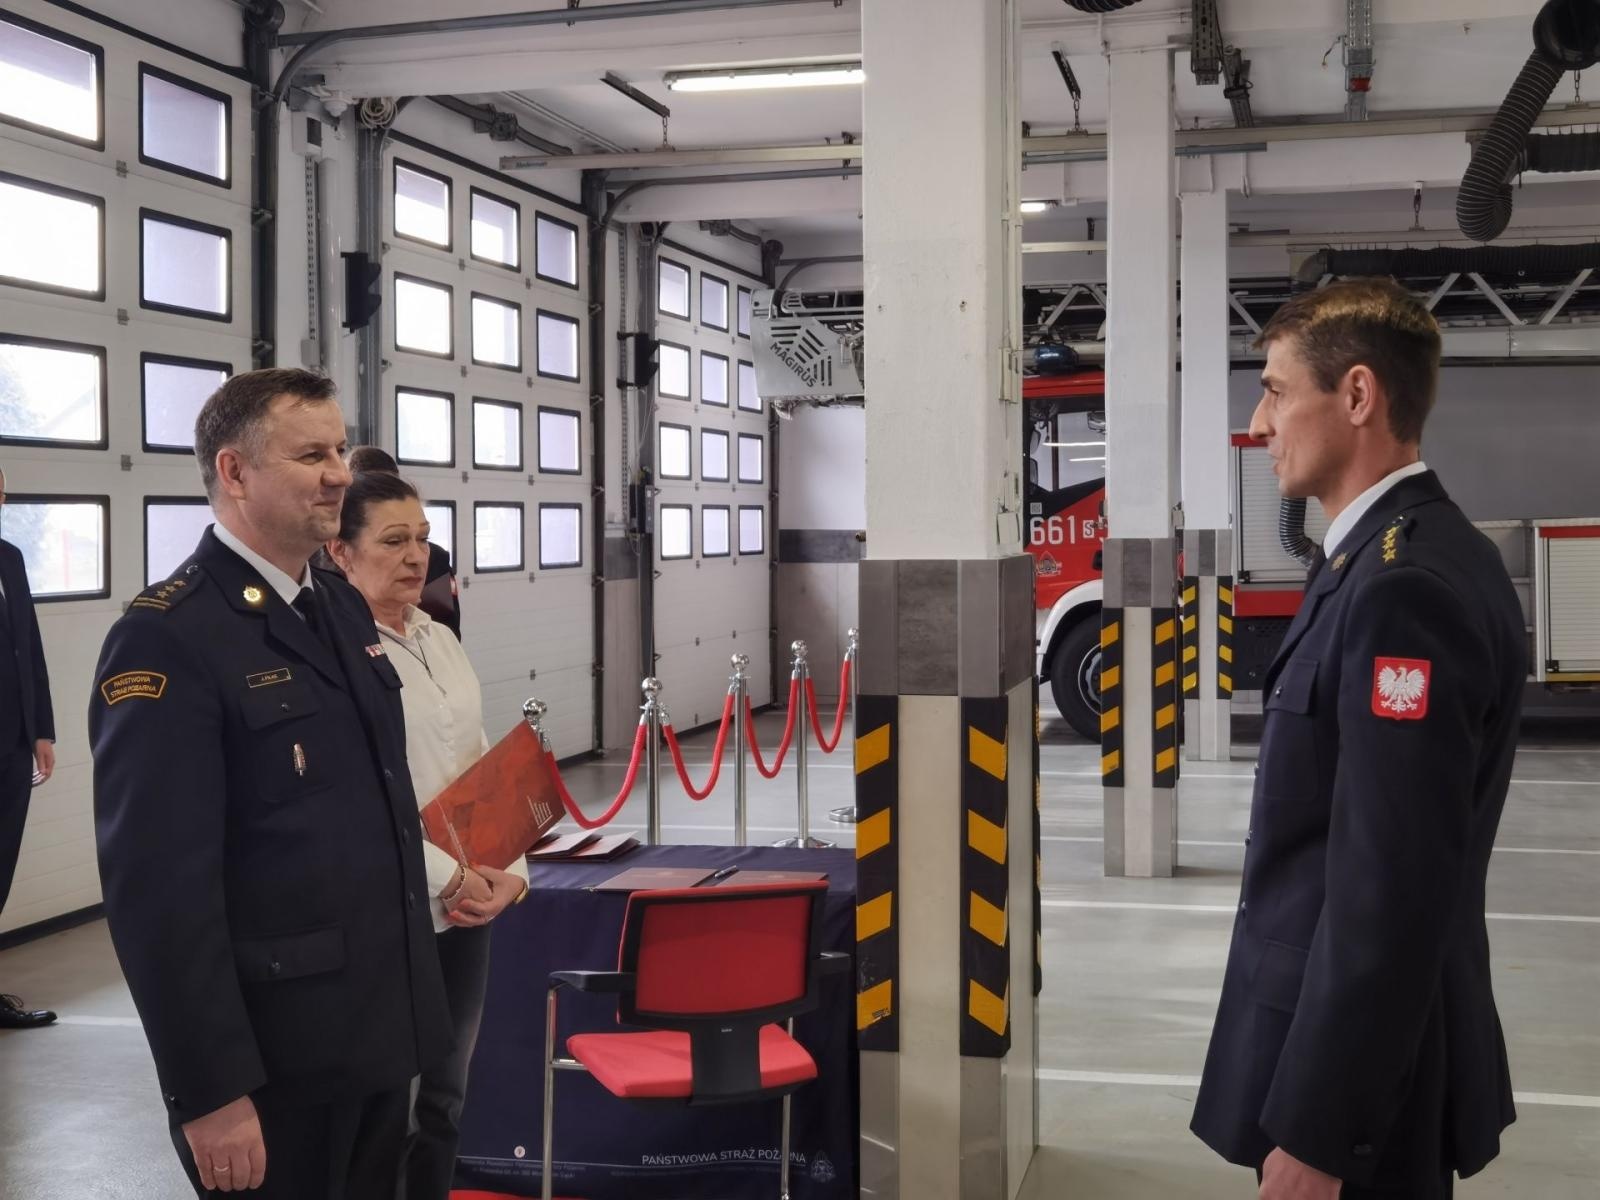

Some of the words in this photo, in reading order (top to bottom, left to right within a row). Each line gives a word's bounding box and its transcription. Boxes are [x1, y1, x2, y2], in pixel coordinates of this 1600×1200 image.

[770, 342, 816, 387] MAGIRUS
[1030, 515, 1076, 545] 661
[642, 1152, 717, 1165] PAŃSTWOWA
[720, 1147, 755, 1160] STRAŻ
[758, 1147, 806, 1162] POŻNA
